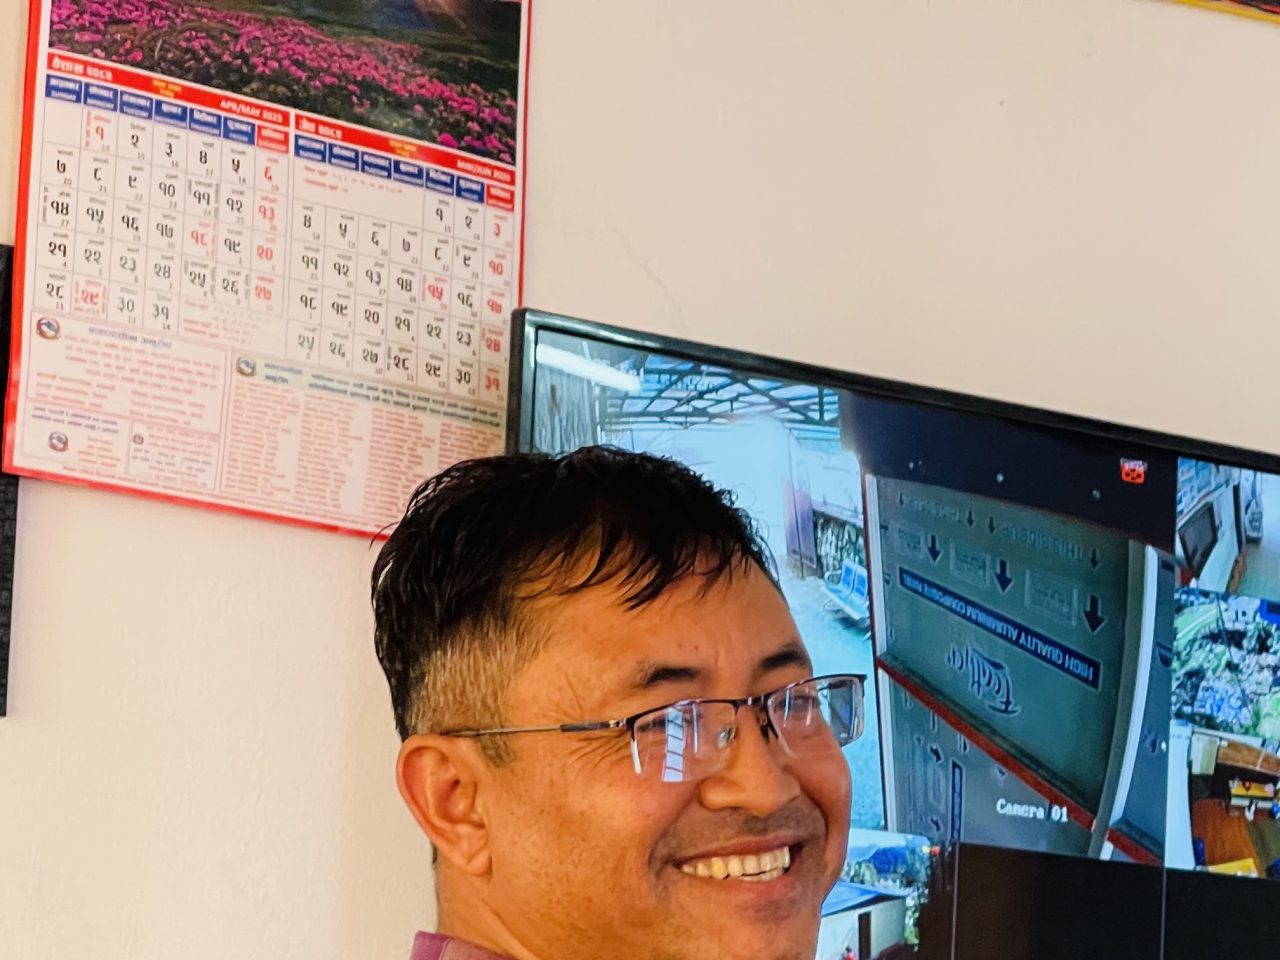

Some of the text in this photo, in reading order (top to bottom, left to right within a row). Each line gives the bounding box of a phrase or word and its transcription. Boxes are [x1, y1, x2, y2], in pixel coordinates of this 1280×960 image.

[96, 126, 272, 182] १ २ ३ ४ ५ ६
[56, 160, 66, 174] ७
[94, 168, 102, 182] ८
[128, 175, 138, 188] ९
[159, 182, 176, 198] १०
[194, 190, 210, 206] ११
[226, 197, 243, 213] १२
[50, 200, 70, 216] १४
[86, 208, 104, 224] १५
[122, 214, 140, 232] १६
[156, 222, 174, 238] १७
[224, 238, 241, 254] १९
[436, 208, 444, 222] १
[465, 216, 472, 229] २
[48, 242, 67, 258] २१
[85, 248, 102, 264] २२
[120, 256, 136, 272] २३
[154, 263, 171, 278] २४
[190, 271, 206, 288] २५
[222, 278, 239, 296] २६
[304, 215, 504, 276] ४ ५ ६ ७ ८ ९ १०
[46, 283, 64, 300] २८
[117, 296, 134, 312] ३०
[152, 304, 169, 320] ३१
[302, 254, 318, 271] ११
[334, 262, 350, 278] १२
[366, 269, 382, 286] १३
[396, 277, 412, 292] १४
[458, 292, 473, 309] १६
[300, 294, 317, 311] १८
[332, 301, 348, 317] १९
[364, 308, 380, 324] २०
[395, 316, 411, 332] २१
[426, 324, 442, 340] २२
[456, 330, 472, 347] २३
[298, 334, 501, 392] २५ २६ २७ २८ २९ ३० ३१
[1018, 631, 1063, 665] QUALITY
[1064, 654, 1093, 681] HIGH
[946, 644, 1022, 717] Feather
[996, 798, 1068, 822] Camera 01
